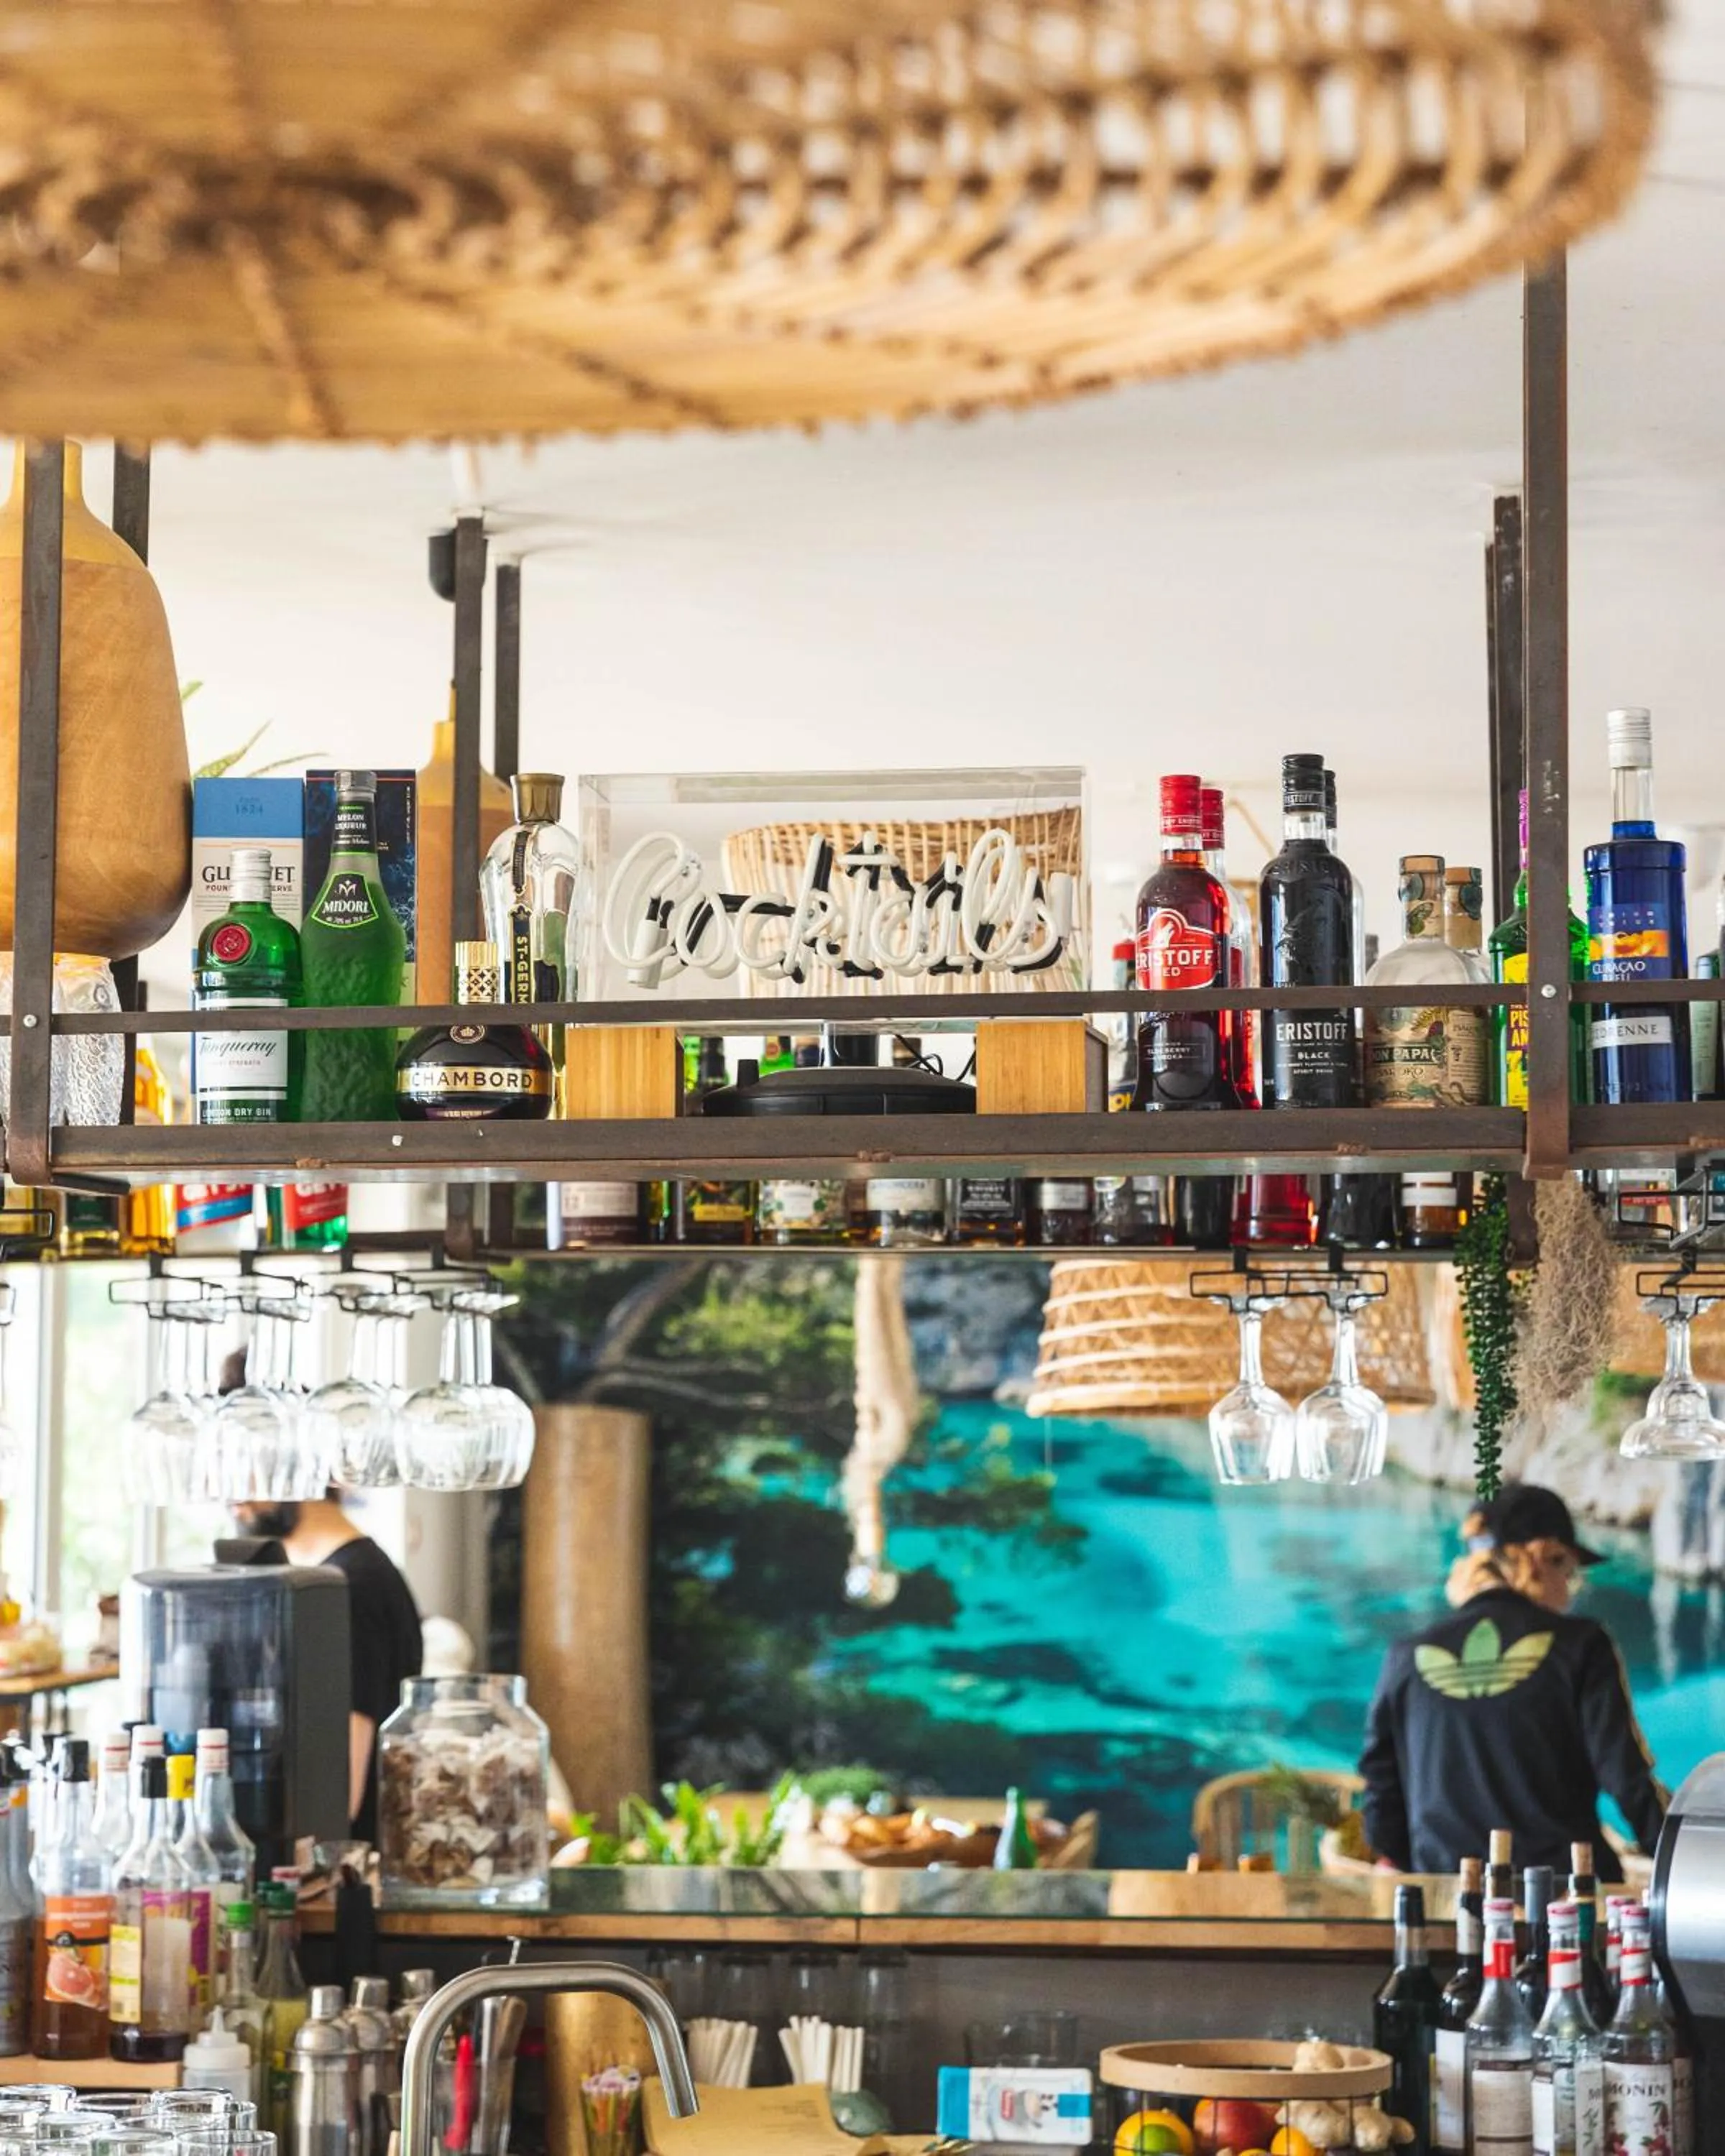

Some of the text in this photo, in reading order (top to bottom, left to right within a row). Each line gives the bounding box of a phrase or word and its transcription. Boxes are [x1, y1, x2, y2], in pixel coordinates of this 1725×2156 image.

[322, 900, 370, 913] MIDORI
[516, 936, 529, 1004] ST-GERM
[1276, 1022, 1348, 1041] ERISTOFF
[1297, 1051, 1330, 1060] BLACK
[1393, 1048, 1430, 1061] PAPA
[411, 1071, 533, 1089] CHAMBORD
[234, 1107, 252, 1116] DRY
[255, 1107, 272, 1116] GIN
